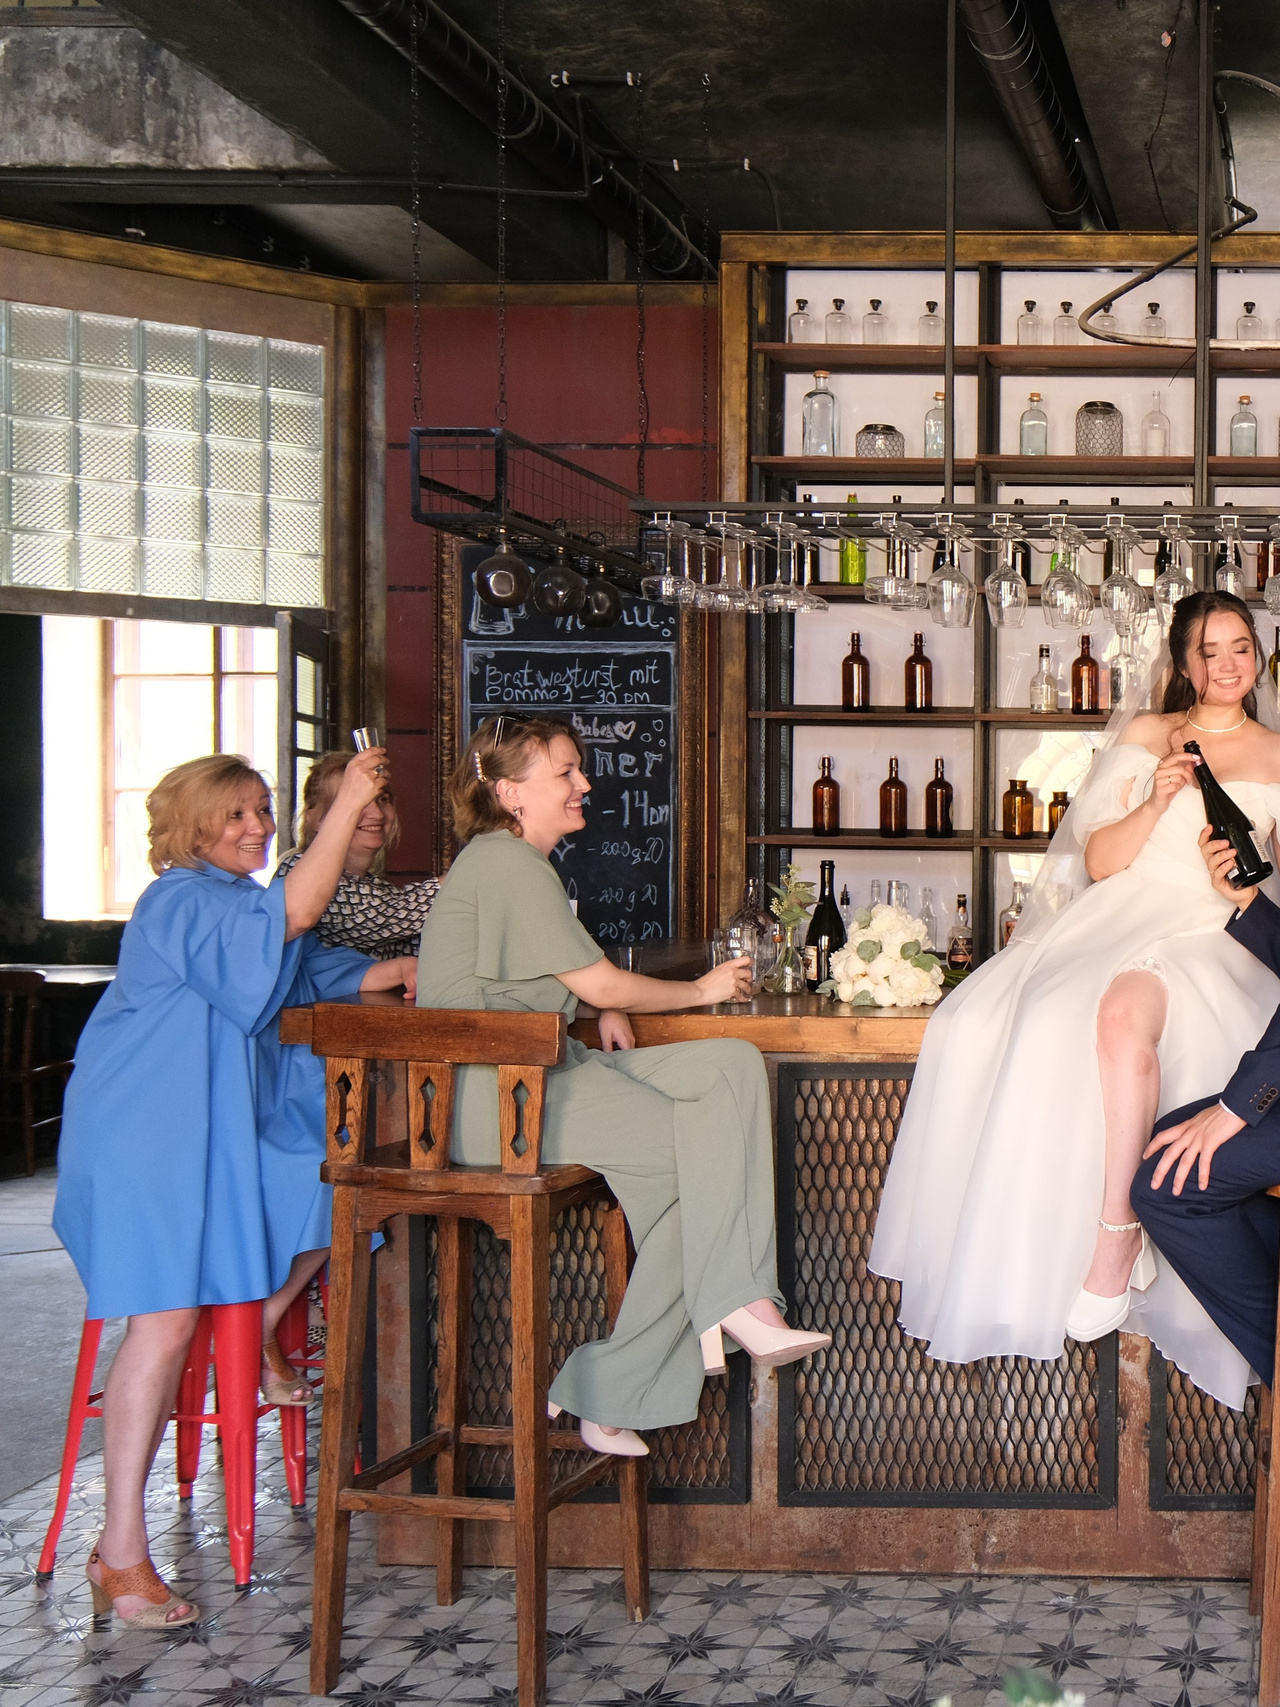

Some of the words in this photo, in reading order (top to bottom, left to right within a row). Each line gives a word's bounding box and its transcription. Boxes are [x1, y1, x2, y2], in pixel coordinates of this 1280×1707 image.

[629, 659, 661, 686] mit
[485, 685, 573, 703] Pommes
[585, 747, 664, 778] ner
